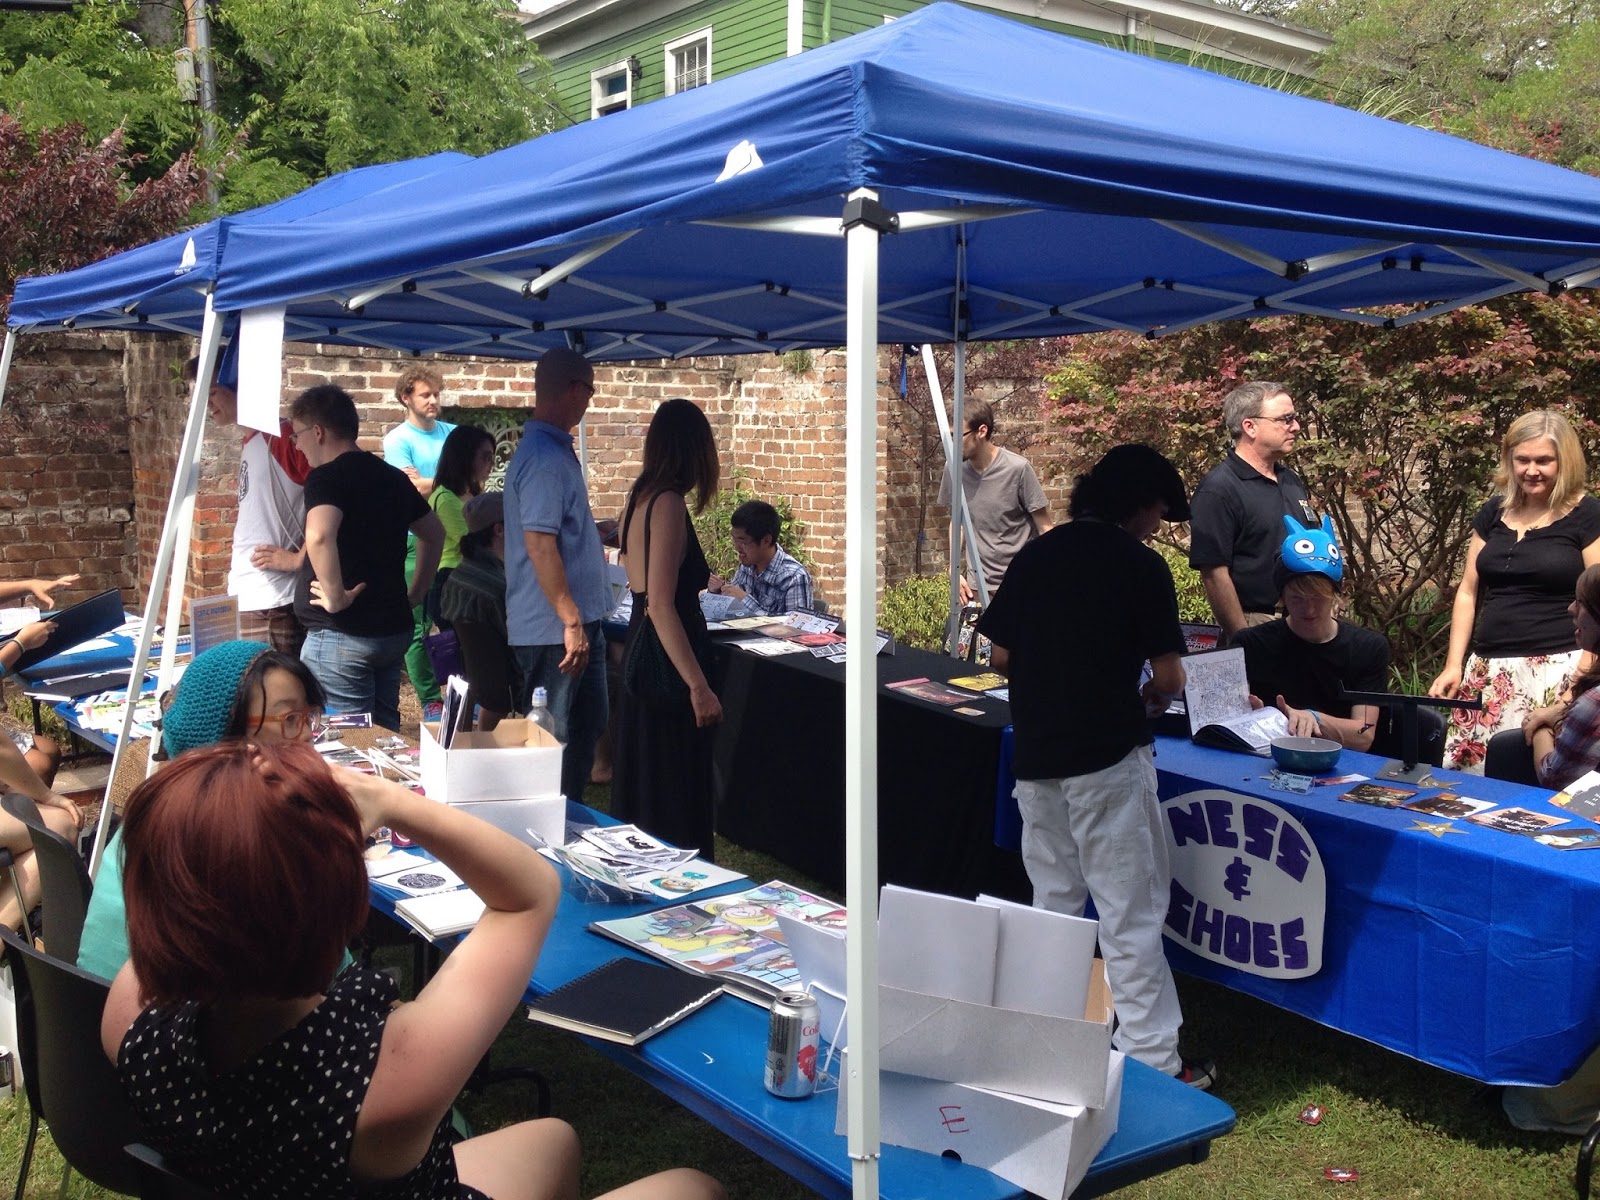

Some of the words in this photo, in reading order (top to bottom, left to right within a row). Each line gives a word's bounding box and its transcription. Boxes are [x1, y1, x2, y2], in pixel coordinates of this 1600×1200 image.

[1167, 799, 1311, 883] NESS
[1223, 856, 1251, 901] &
[1164, 878, 1308, 970] SHOES
[938, 1105, 970, 1133] E
